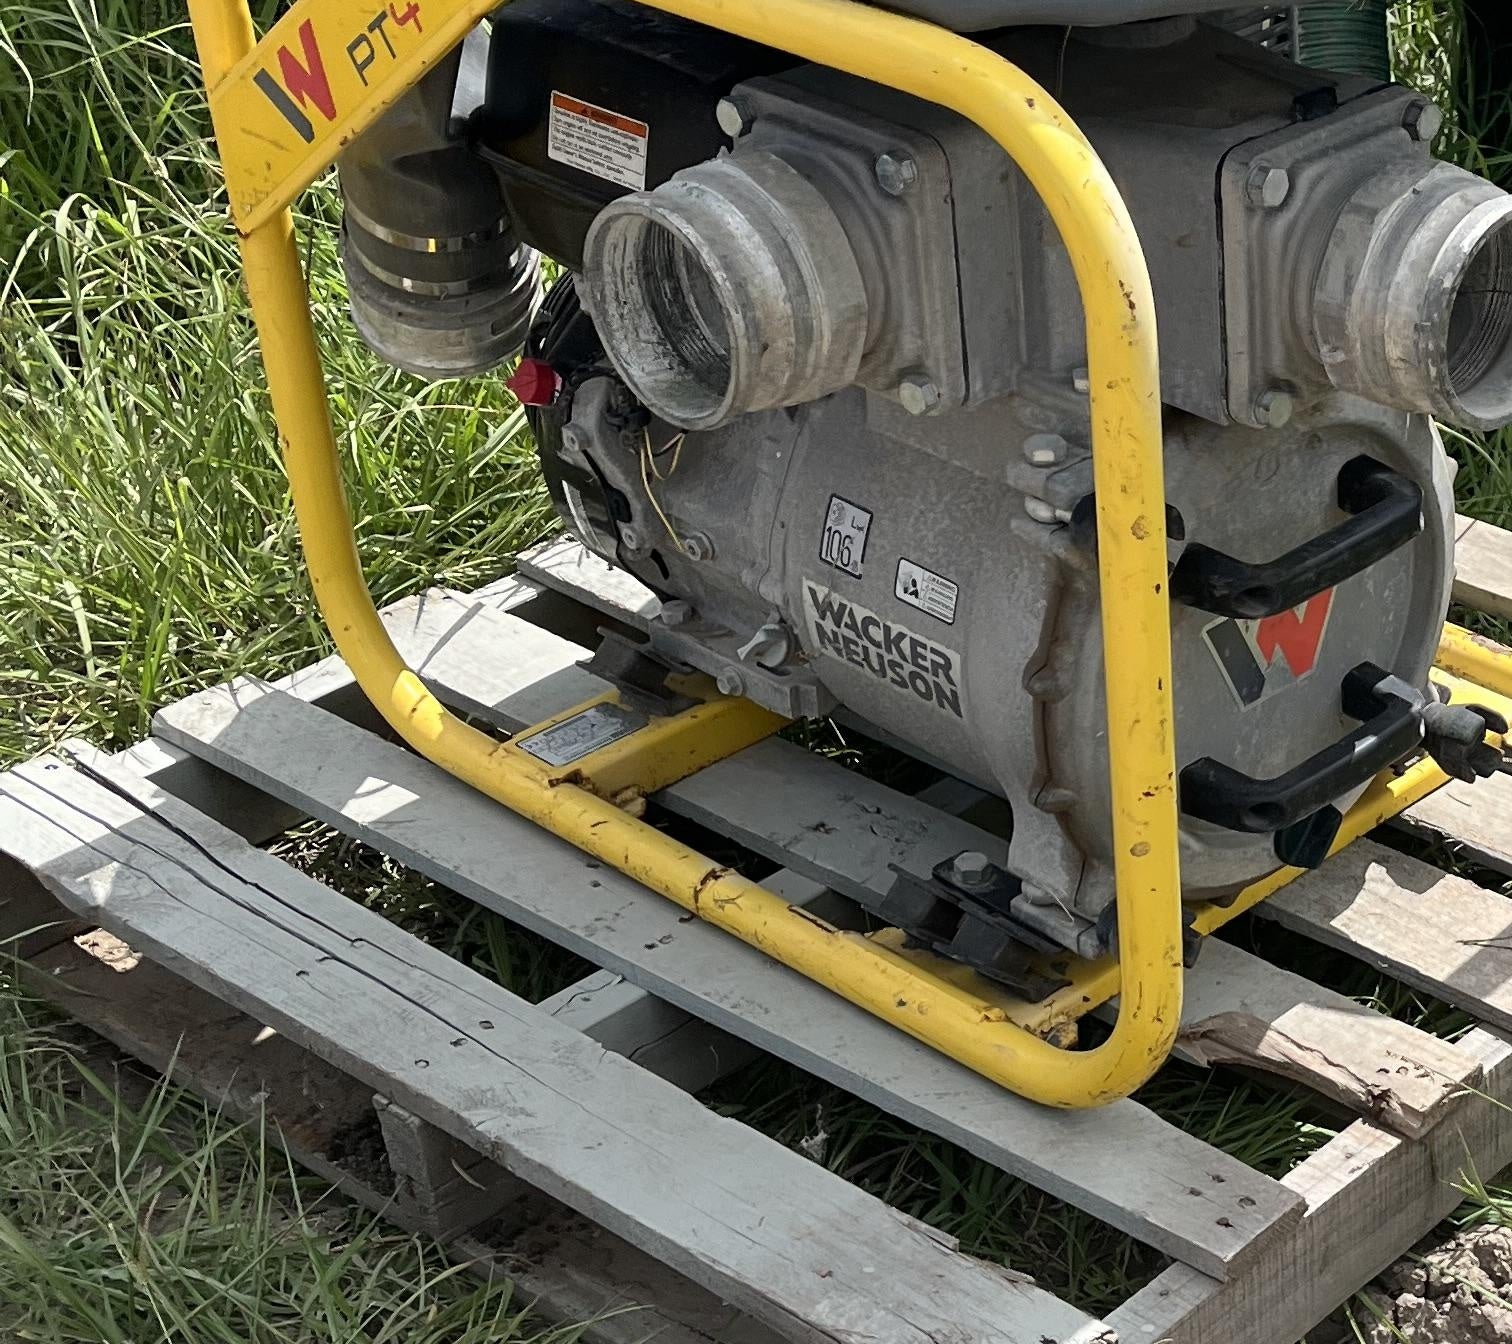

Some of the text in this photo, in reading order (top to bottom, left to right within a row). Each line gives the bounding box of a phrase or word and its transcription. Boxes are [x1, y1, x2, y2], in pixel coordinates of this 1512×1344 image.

[346, 1, 422, 87] PT4
[825, 525, 853, 568] 106
[807, 585, 957, 687] WACKER
[814, 620, 963, 719] NEUSON
